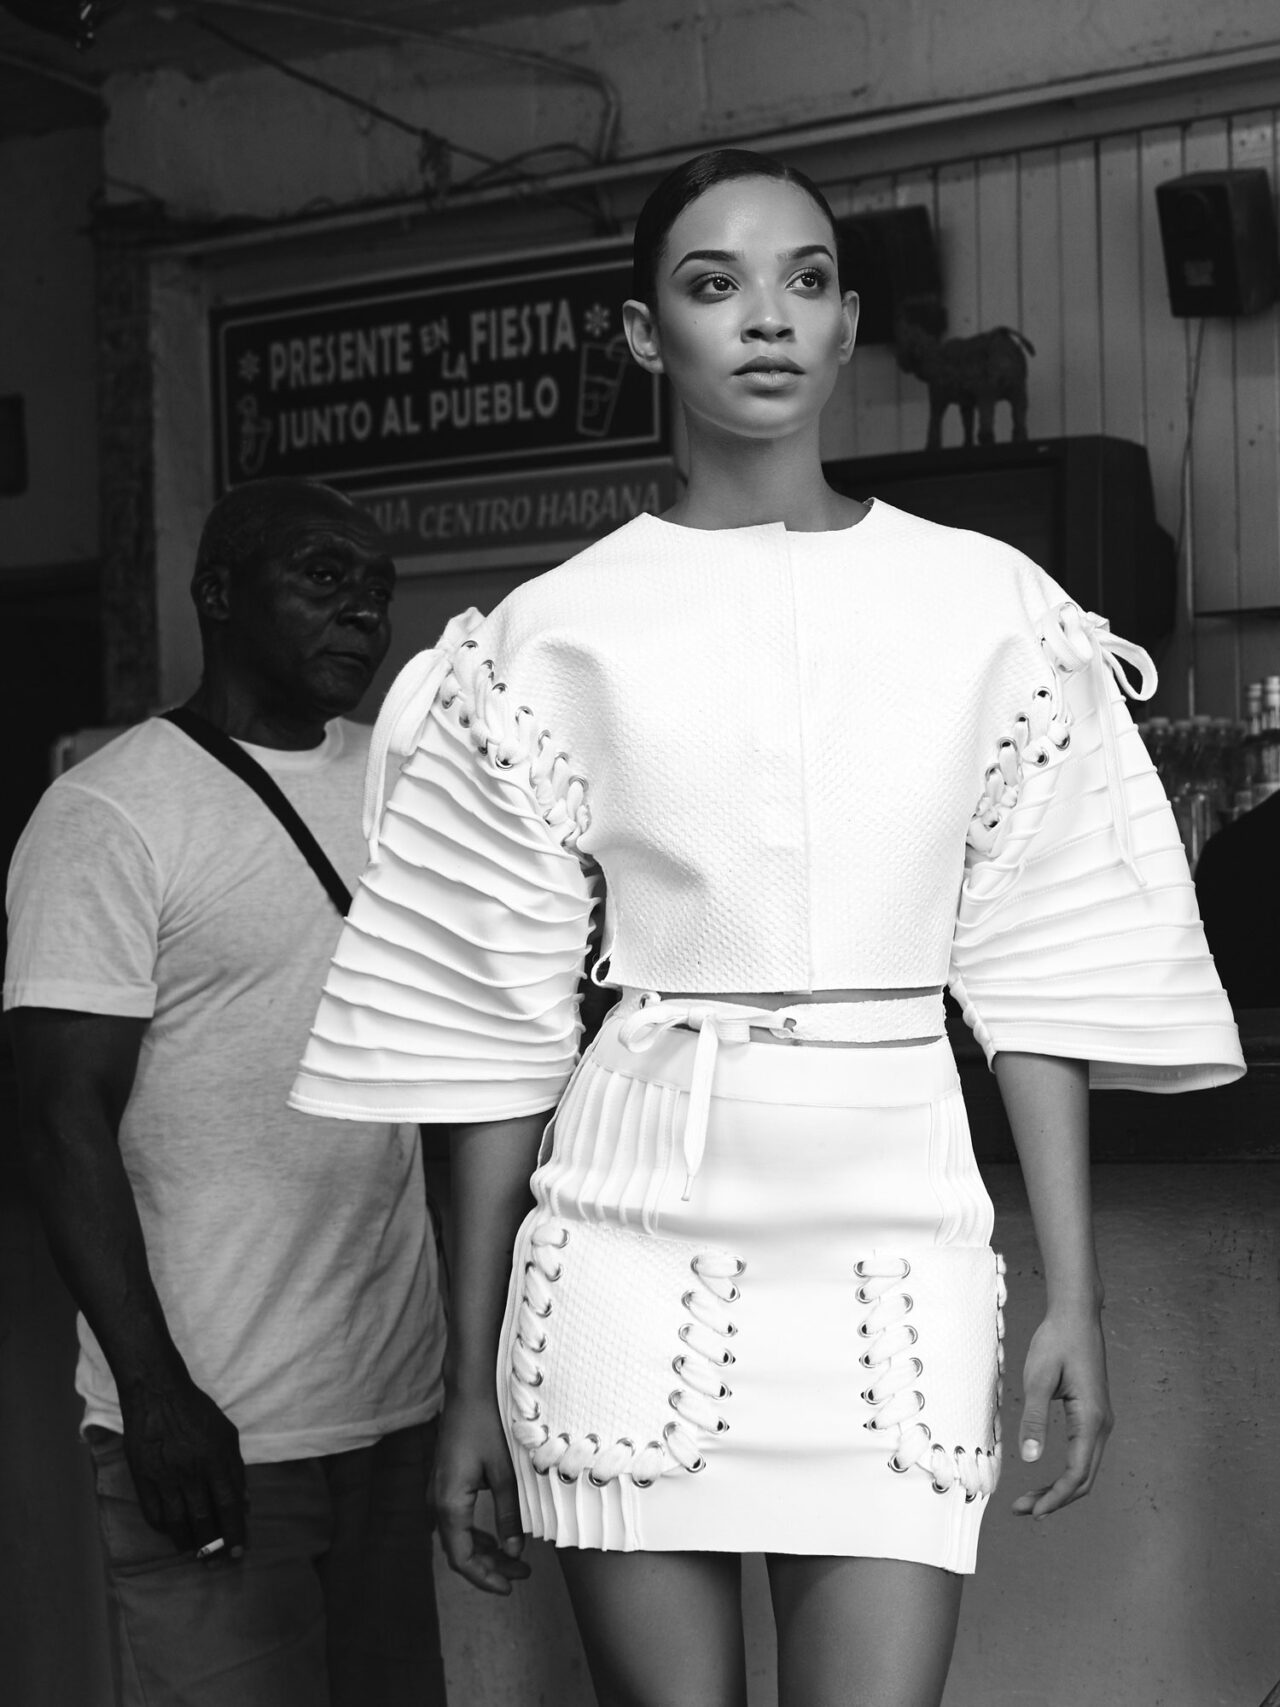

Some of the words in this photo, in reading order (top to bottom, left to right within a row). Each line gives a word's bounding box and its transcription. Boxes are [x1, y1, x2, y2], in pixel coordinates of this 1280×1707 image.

[269, 322, 412, 392] PRESENTE
[420, 316, 449, 355] EN
[441, 350, 468, 379] LA
[470, 299, 576, 365] FIESTA
[279, 402, 371, 454] JUNTO
[382, 398, 419, 436] AL
[430, 376, 559, 431] PUEBLO
[418, 495, 531, 540] CENTRO
[536, 481, 660, 531] HABANA
